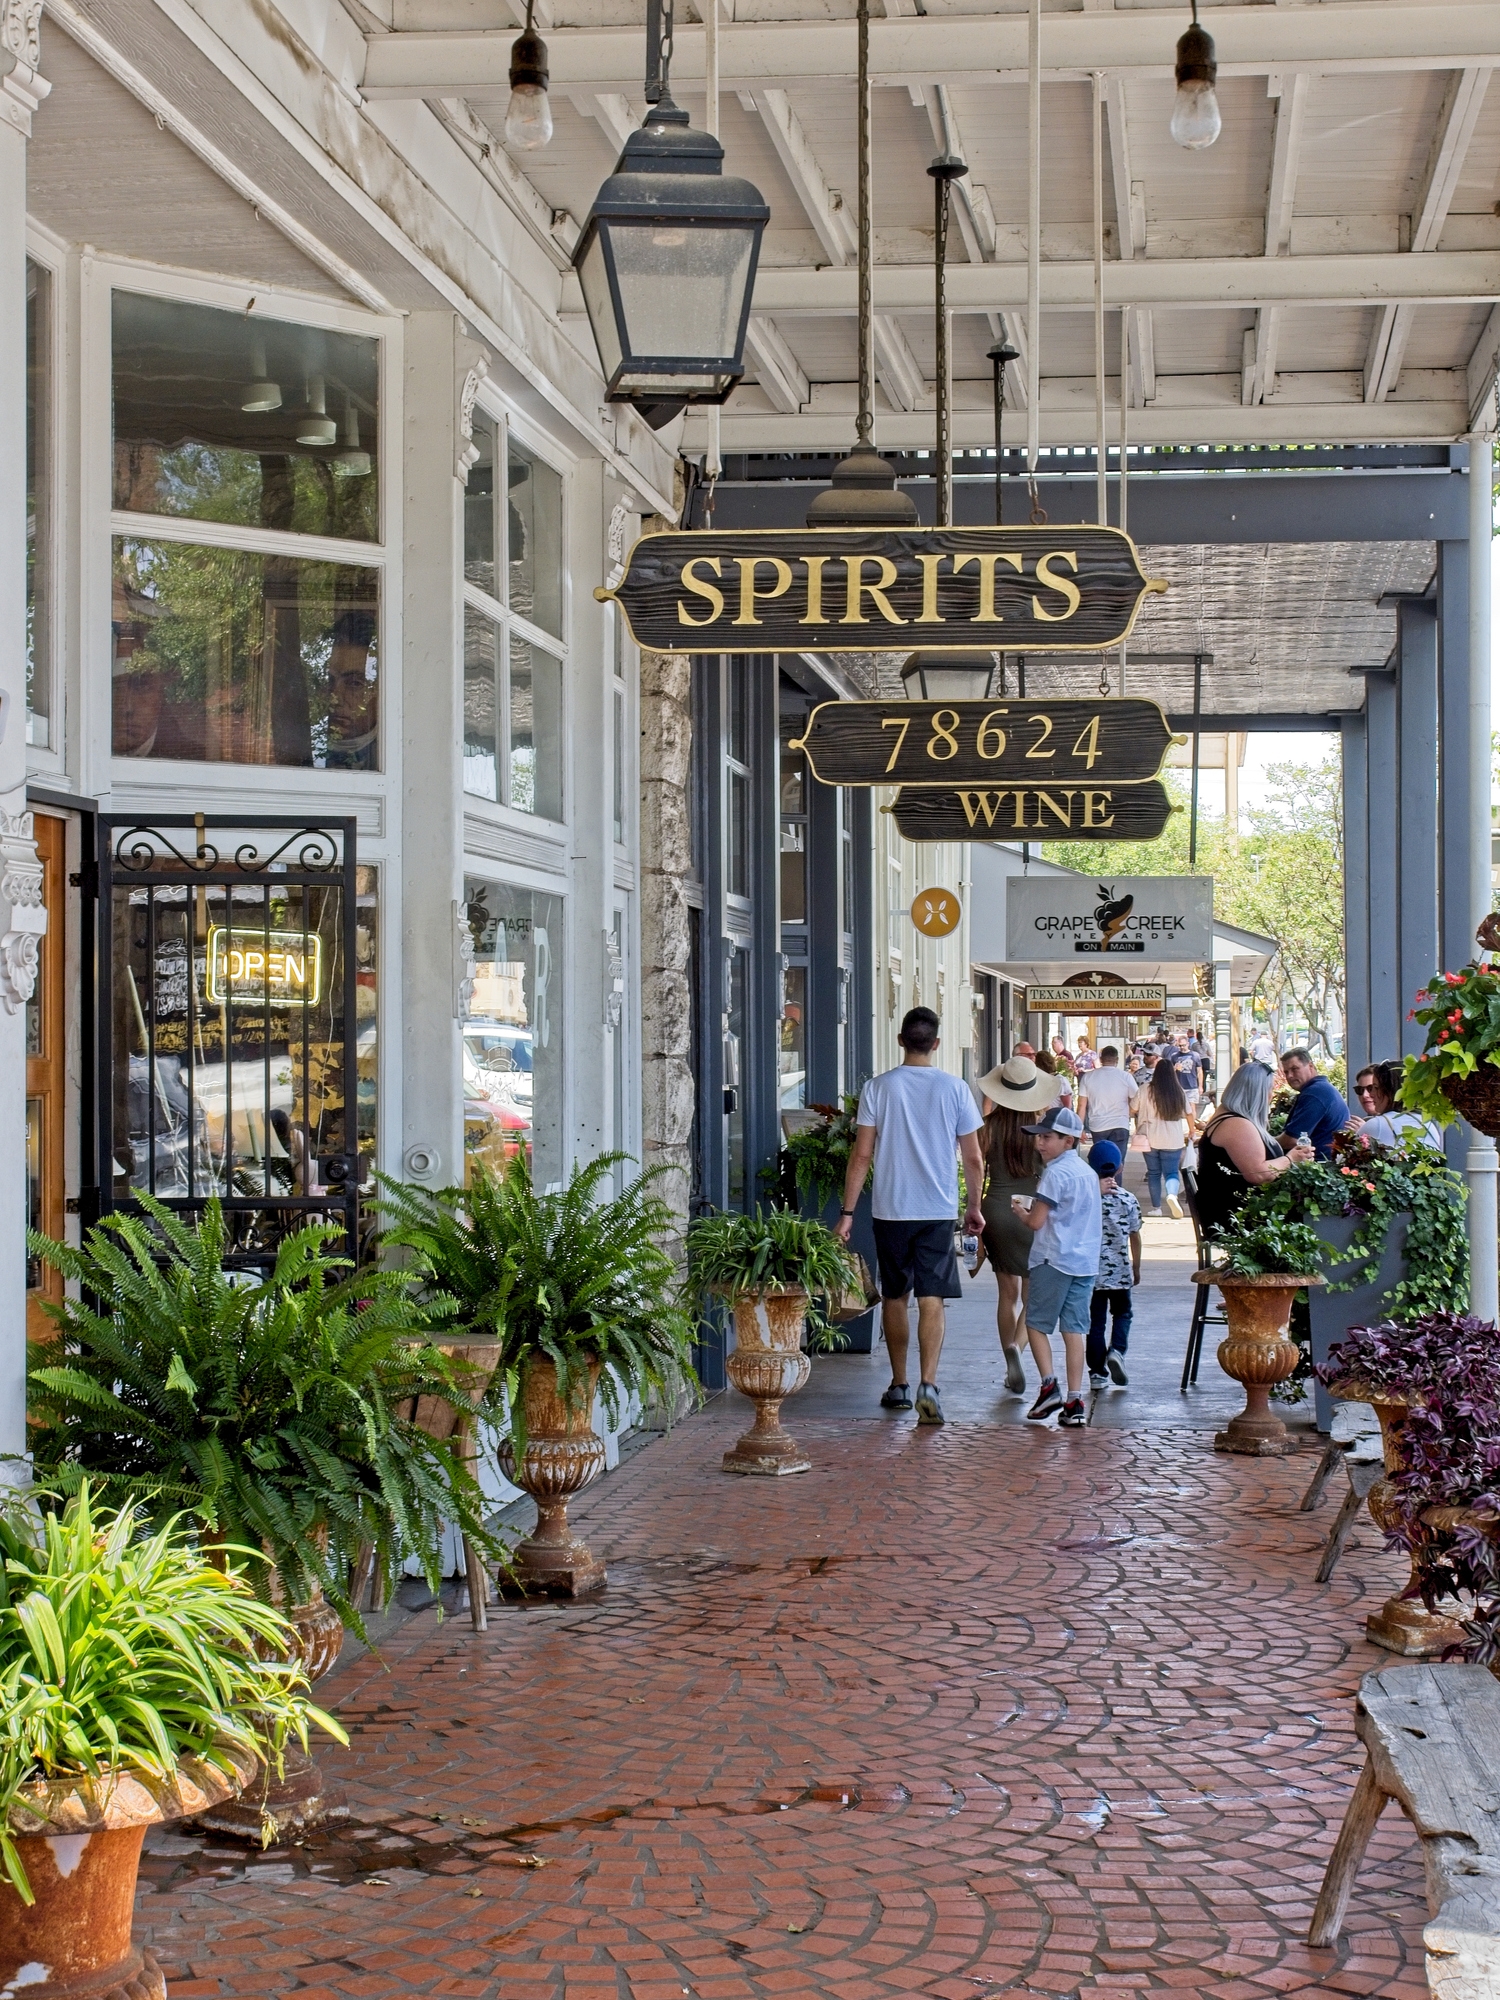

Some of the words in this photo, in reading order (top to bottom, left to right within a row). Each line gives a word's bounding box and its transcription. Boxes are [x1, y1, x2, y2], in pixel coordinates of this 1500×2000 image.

[677, 551, 1081, 627] SPIRITS
[881, 708, 1103, 773] 78624
[954, 790, 1115, 828] WINE
[1034, 916, 1094, 931] GRAPE
[1125, 915, 1185, 931] CREEK
[1046, 932, 1175, 940] VINEYARDS
[1082, 943, 1098, 951] ON
[1110, 943, 1136, 951] MAIN
[223, 950, 305, 983] OPEN
[1029, 988, 1070, 1000] TEXAS
[1073, 988, 1105, 1000] WINE
[1107, 988, 1162, 1000] CELLARS
[1034, 1001, 1058, 1010] BEER
[1063, 1001, 1086, 1009] WINE
[1094, 1001, 1123, 1009] BELLINI
[1130, 1000, 1158, 1009] MIMOSA
